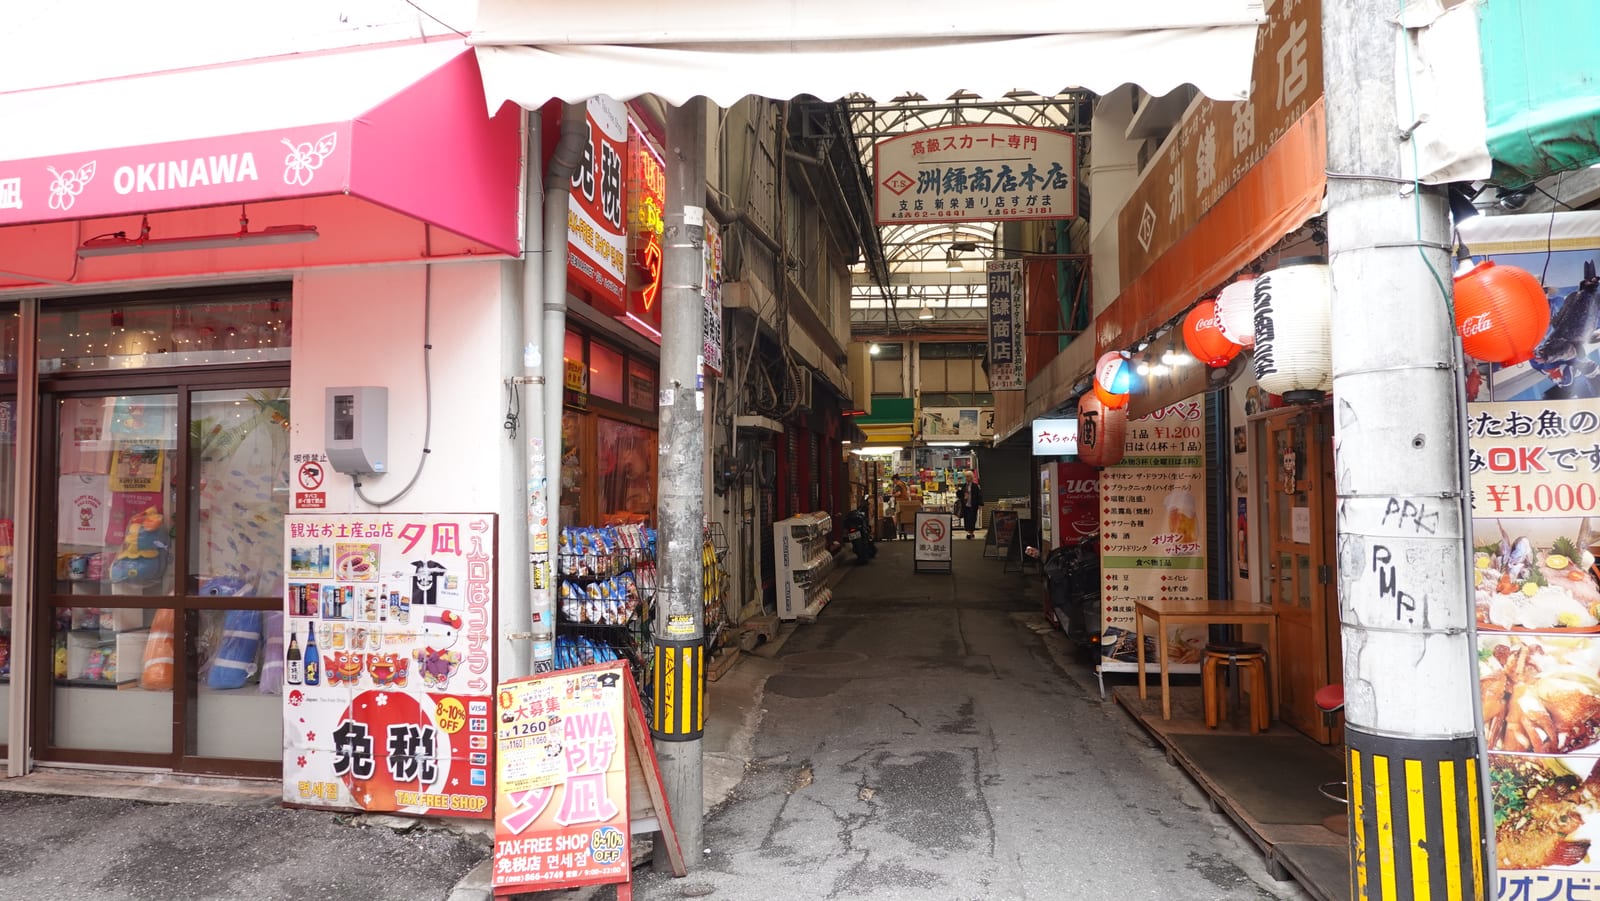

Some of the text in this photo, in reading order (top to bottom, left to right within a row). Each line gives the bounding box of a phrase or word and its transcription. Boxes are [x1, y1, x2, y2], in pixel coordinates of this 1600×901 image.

[912, 133, 1038, 156] 高級スカート専門
[113, 151, 258, 195] OKINAWA
[916, 162, 1069, 196] 洲鎌商店本店
[899, 199, 924, 211] 支店
[991, 274, 1012, 360] 洲鎌商店
[290, 522, 462, 555] 観光お土産品店 夕凪
[1152, 534, 1183, 545] オリオン
[514, 697, 561, 721] 大募集
[440, 718, 459, 731] OFF
[333, 721, 438, 783] 免税
[451, 796, 487, 811] SHOP
[498, 834, 589, 857] TAX-FREE SHOP
[594, 851, 619, 862] OFF
[497, 853, 587, 873] 免税店 면세점
